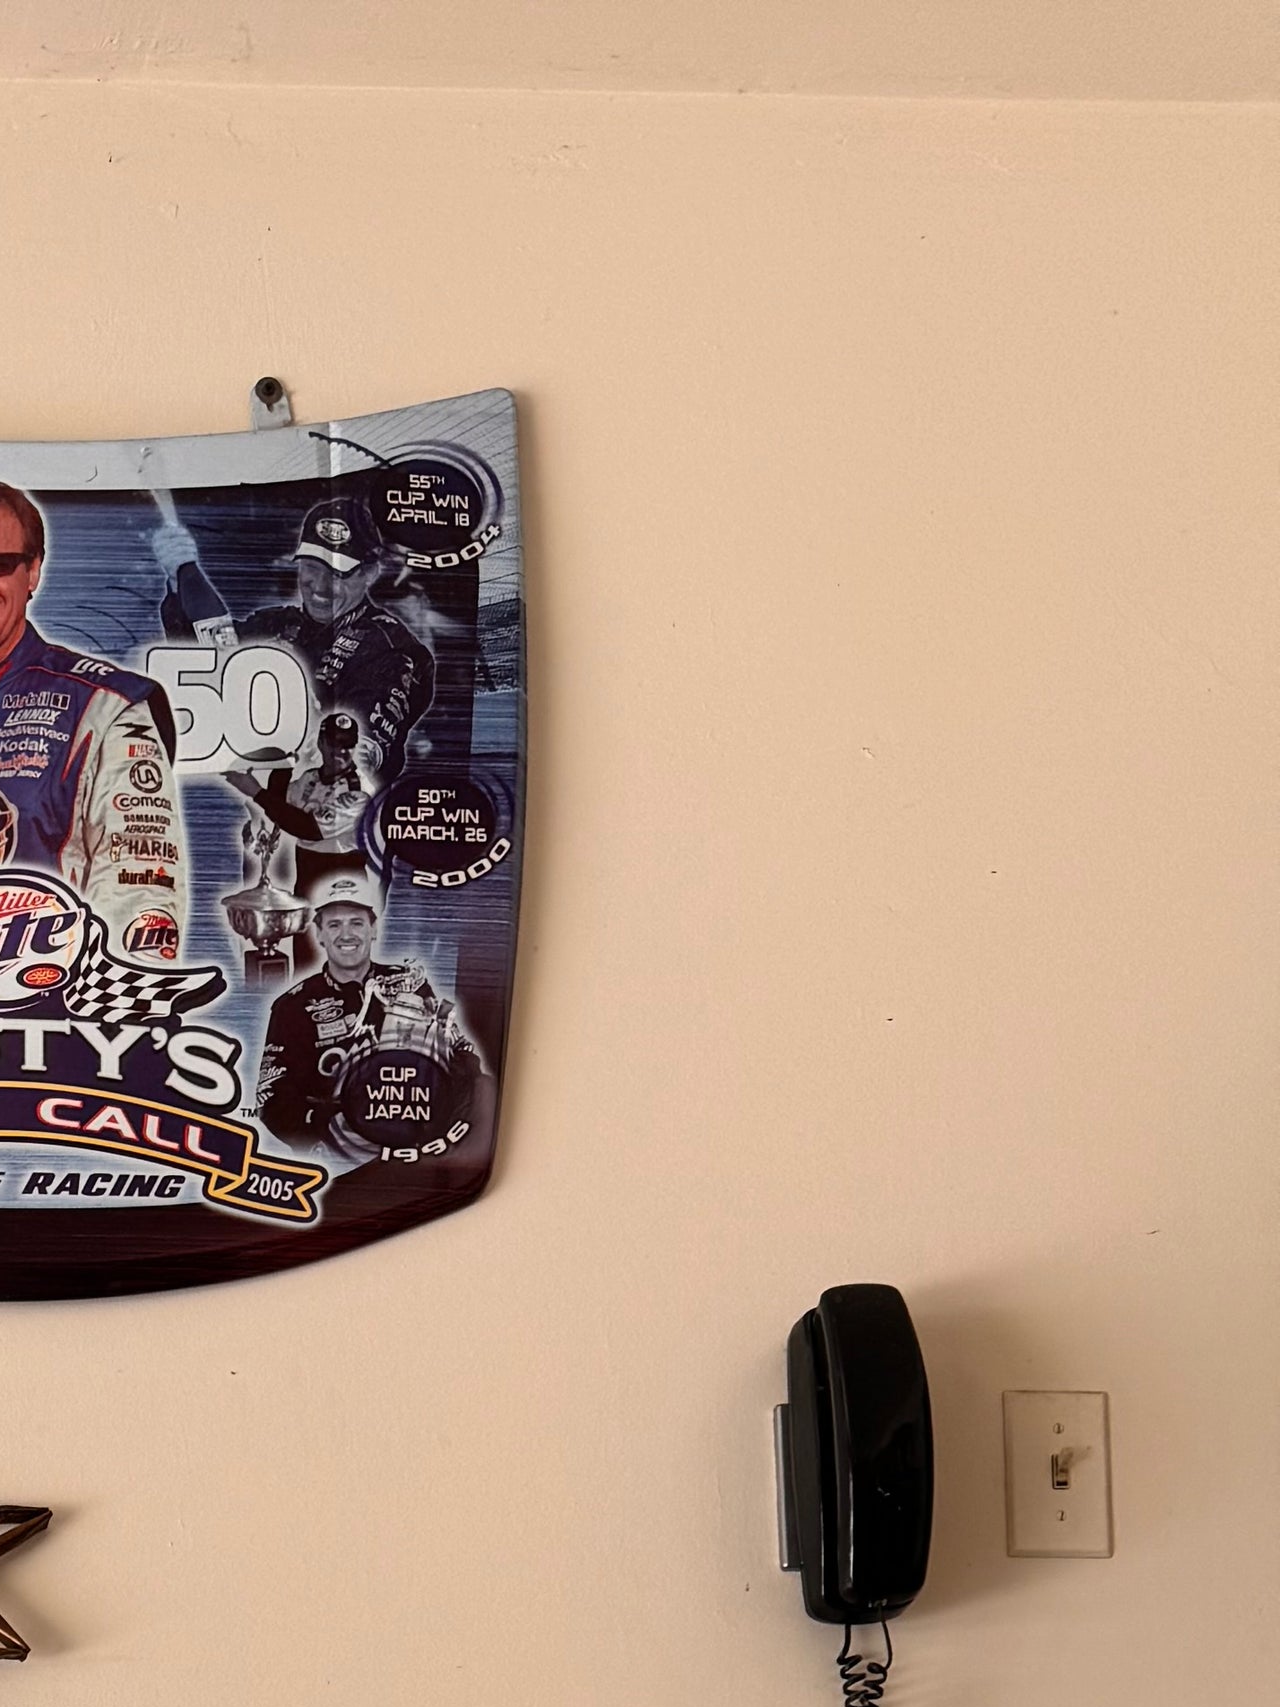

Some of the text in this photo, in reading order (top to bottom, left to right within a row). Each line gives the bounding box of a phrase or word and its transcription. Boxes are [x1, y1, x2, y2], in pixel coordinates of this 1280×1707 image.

[386, 490, 469, 510] CUP WIN
[454, 512, 470, 527] 18
[406, 523, 502, 570] 2004
[146, 645, 308, 761] 50
[6, 709, 62, 723] LENNOX
[394, 807, 480, 825] CUP WIN
[387, 824, 488, 843] MARCH. 26
[412, 838, 512, 888] 2000
[379, 1066, 417, 1083] CUP
[366, 1085, 430, 1103] WIN IN
[365, 1103, 431, 1121] JAPAN
[36, 1096, 222, 1164] CALL
[381, 1119, 471, 1164] 1996
[22, 1171, 186, 1199] RACING
[247, 1172, 295, 1201] 2005
